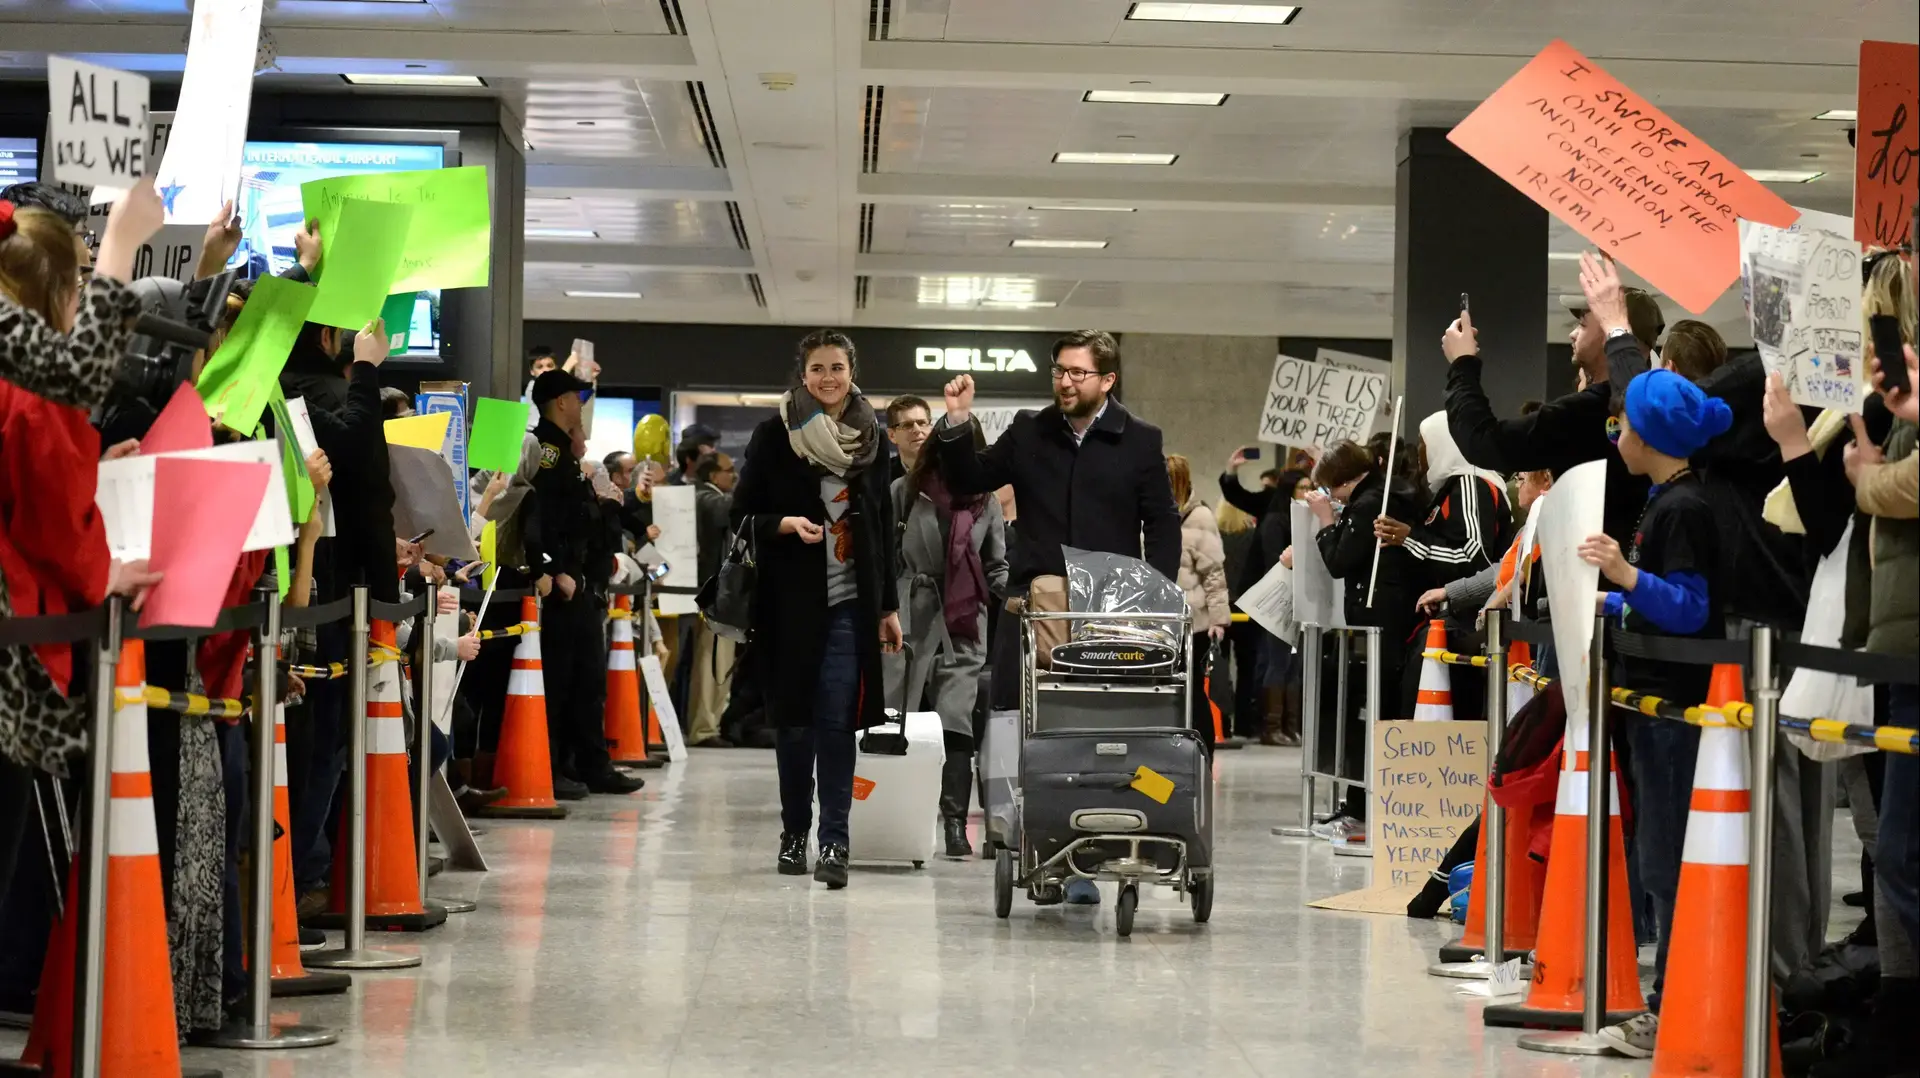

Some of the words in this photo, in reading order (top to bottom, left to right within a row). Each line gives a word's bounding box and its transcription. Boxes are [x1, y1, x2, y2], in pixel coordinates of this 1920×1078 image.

[69, 70, 130, 127] ALL
[1560, 60, 1591, 81] I
[1595, 90, 1687, 152] SWORE
[1687, 160, 1735, 189] AN
[1562, 94, 1622, 136] OATH
[1630, 140, 1655, 159] TO
[104, 137, 142, 177] WE
[248, 151, 343, 165] INTERNATIONAL
[345, 152, 398, 165] AIRPORT
[1527, 97, 1575, 134] AND
[1584, 135, 1668, 196] DEFEND
[1680, 199, 1723, 234] THE
[1562, 167, 1611, 198] NOT
[1516, 164, 1641, 247] TRUMP!
[164, 244, 192, 281] UP
[916, 347, 1037, 372] DELTA
[1275, 359, 1339, 399] GIVE
[1345, 375, 1383, 412] US
[1262, 413, 1307, 439] YOUR
[1270, 392, 1309, 416] YOUR
[1316, 401, 1366, 428] TIRED
[1080, 650, 1145, 661] smartecarte
[1384, 726, 1436, 760] SEND
[1447, 733, 1477, 755] ME
[1379, 767, 1432, 788] TIRED,
[1438, 766, 1484, 787] YOUR
[1380, 791, 1430, 819] YOUR
[1383, 823, 1457, 839] MASSES
[1392, 869, 1420, 886] BE
